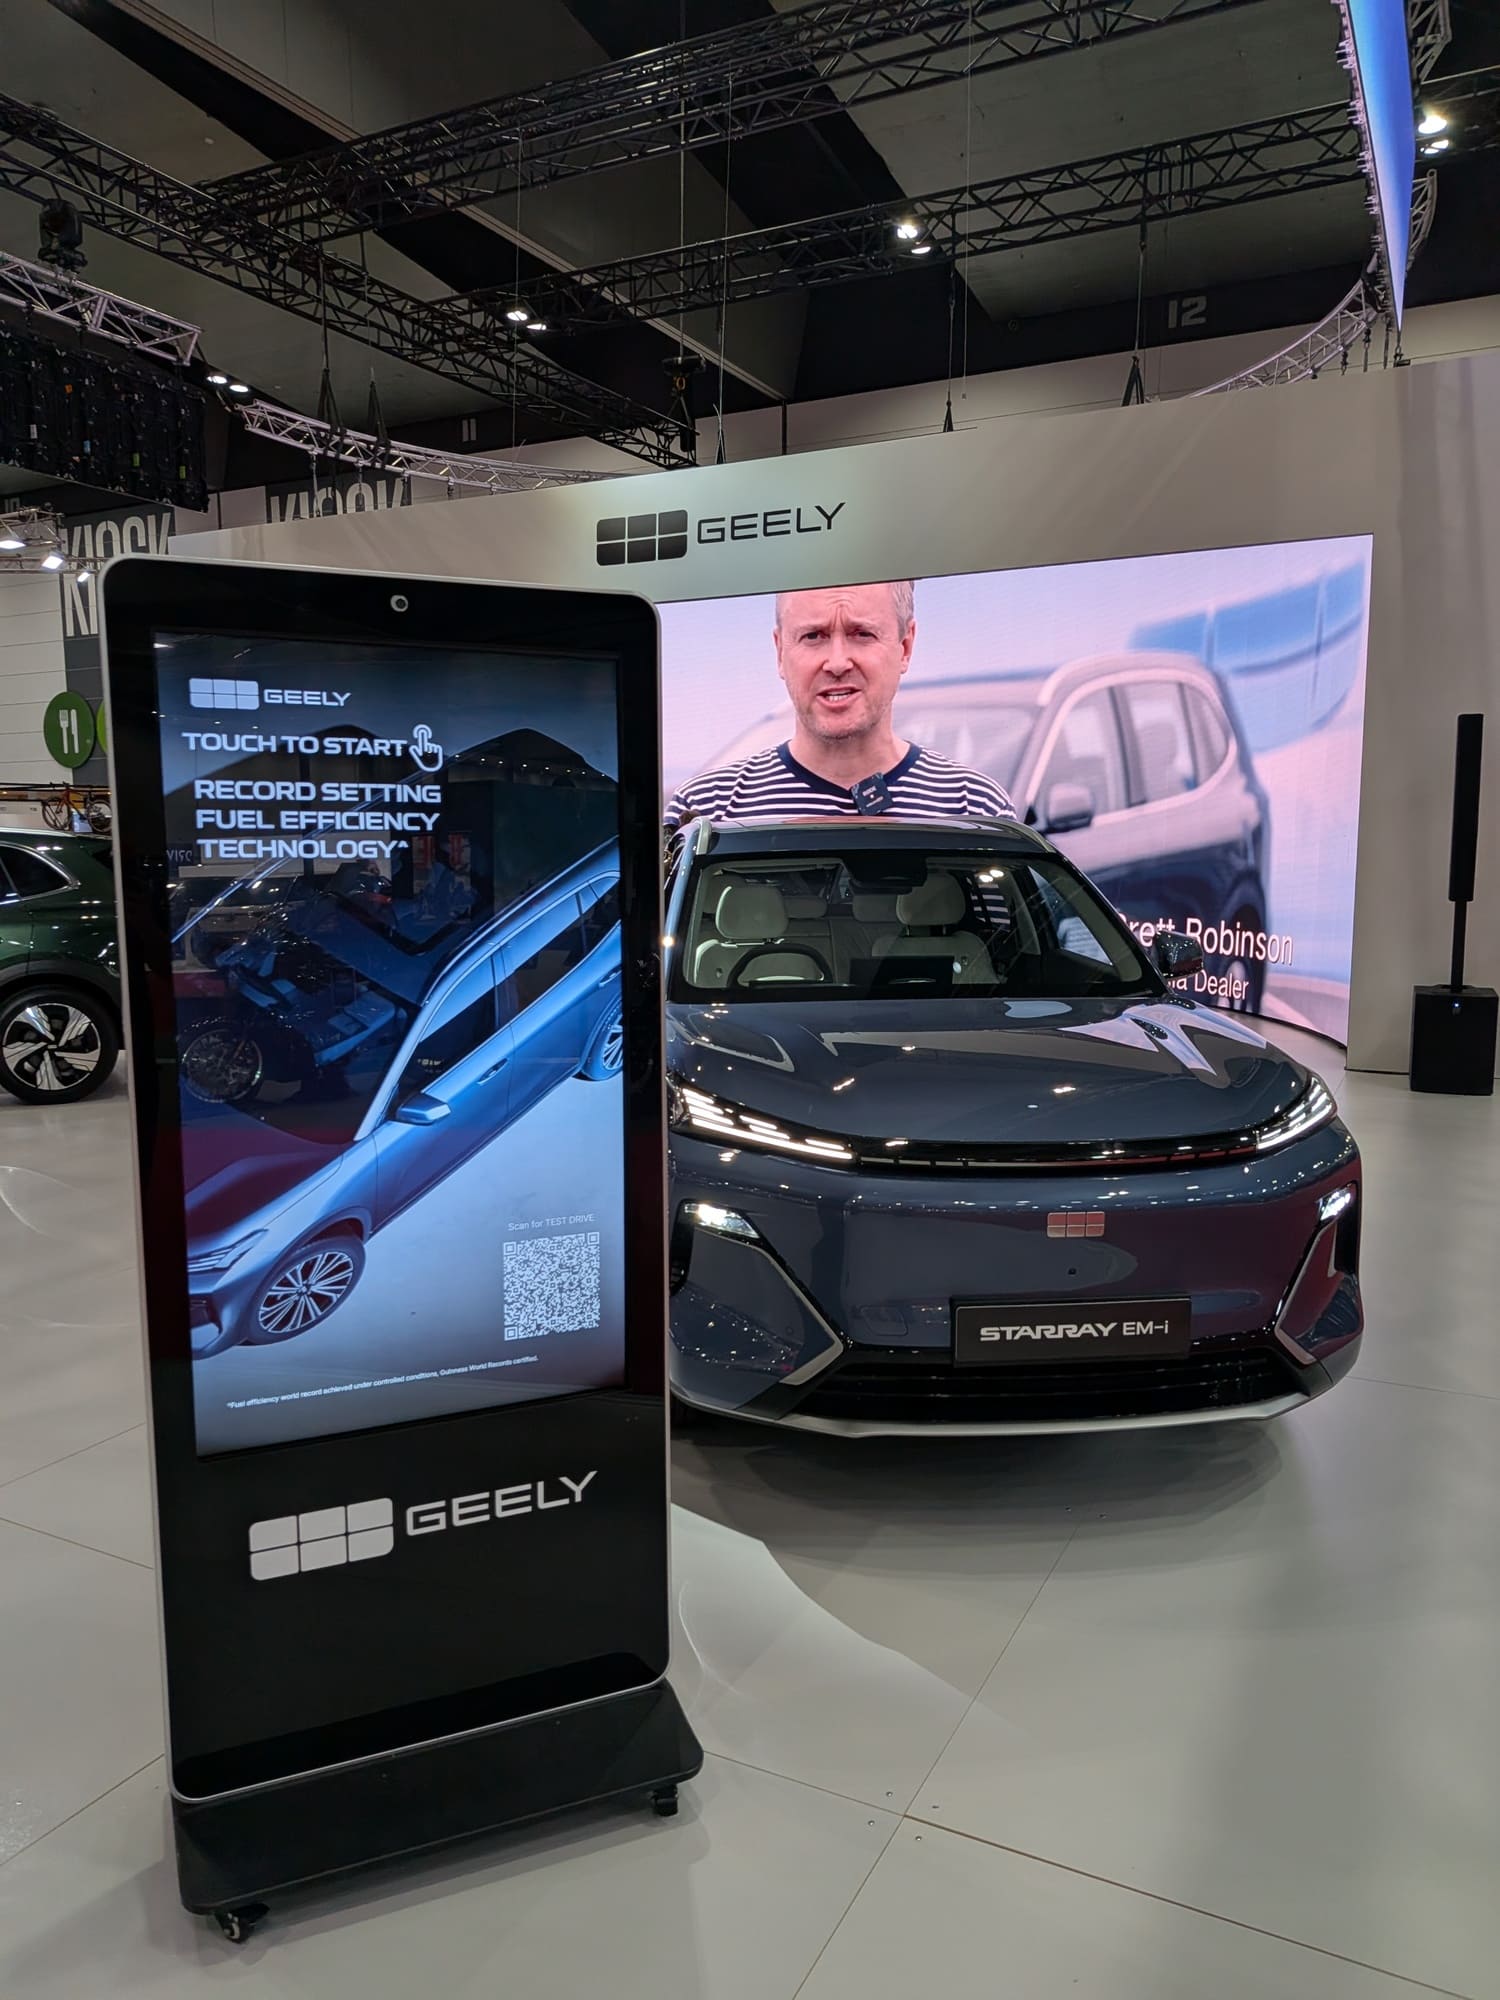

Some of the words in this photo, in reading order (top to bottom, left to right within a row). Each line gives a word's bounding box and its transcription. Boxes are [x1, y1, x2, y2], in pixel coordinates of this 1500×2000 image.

[1168, 295, 1207, 328] 12
[697, 502, 846, 544] GEELY
[263, 688, 351, 706] GEELY
[182, 732, 277, 753] TOUCH
[281, 735, 320, 754] TO
[323, 737, 408, 757] START
[194, 780, 316, 801] RECORD
[321, 783, 441, 803] SETTING
[196, 809, 275, 829] FUEL
[280, 811, 440, 831] EFFICIENCY
[1186, 917, 1293, 966] Robinson
[1194, 969, 1250, 1000] Dealer
[508, 1221, 530, 1231] Scan
[531, 1220, 544, 1229] for
[546, 1216, 567, 1226] TEST
[568, 1214, 595, 1224] DRIVE
[980, 1322, 1119, 1341] STARRAY
[1122, 1320, 1169, 1336] EM-i
[406, 1470, 598, 1536] GEELY
